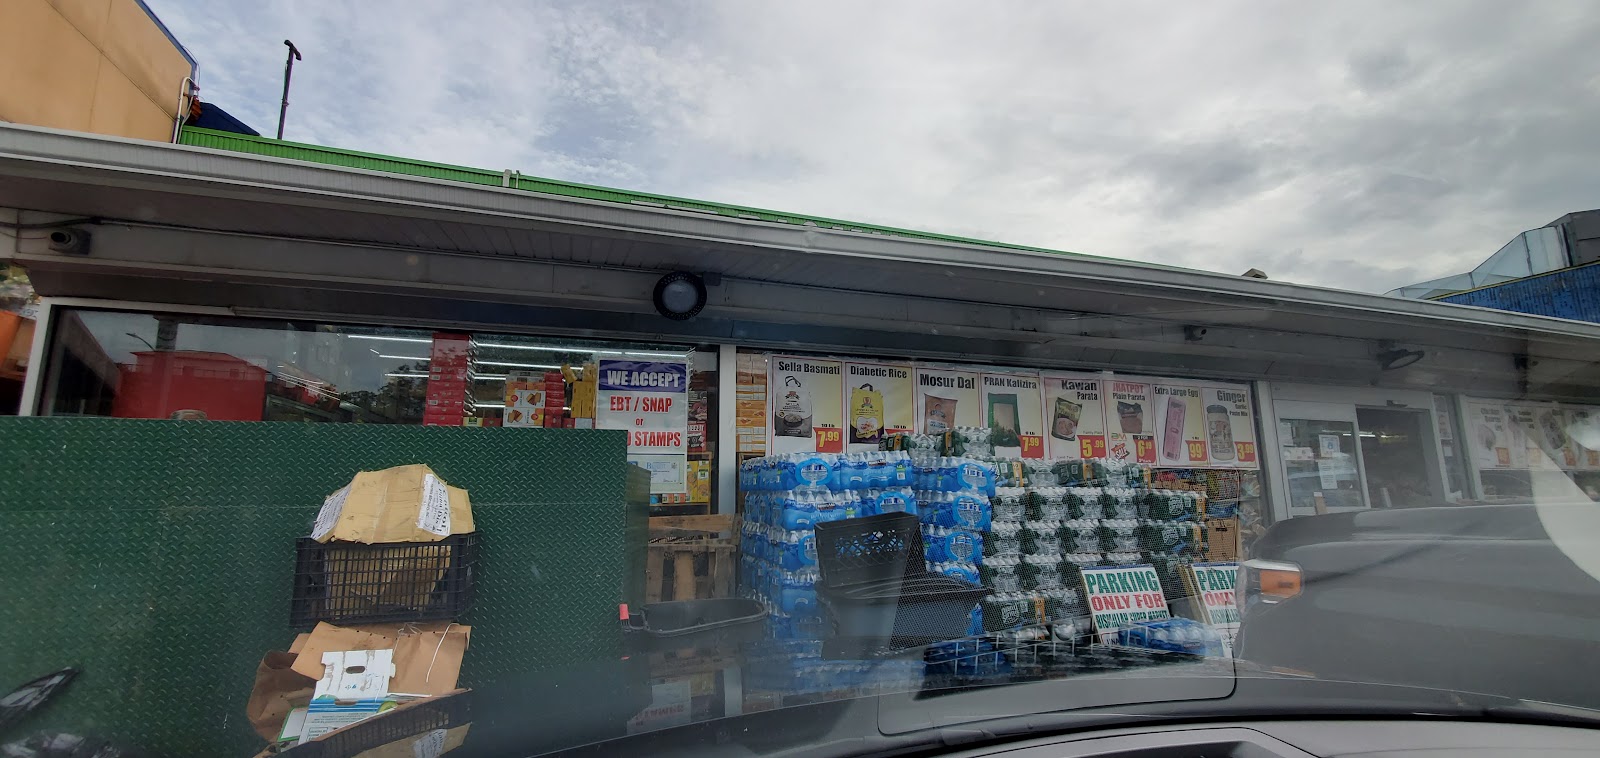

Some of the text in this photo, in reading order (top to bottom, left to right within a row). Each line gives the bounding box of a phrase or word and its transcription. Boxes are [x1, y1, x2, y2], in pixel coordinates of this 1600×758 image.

[778, 361, 840, 374] Sella Basmati
[850, 366, 907, 378] Diabetic Rice
[607, 370, 680, 388] WE ACCEPT
[920, 374, 974, 389] Mosur Dal
[984, 376, 1036, 389] PRAN Kalizira
[1061, 380, 1097, 390] Kawan
[1077, 392, 1098, 400] Parata
[1155, 387, 1199, 397] Extra Large Egg
[1217, 390, 1246, 403] Ginger
[610, 396, 673, 412] EBT / SNAP
[635, 418, 644, 426] or
[634, 431, 680, 447] STAMPS
[818, 431, 839, 447] 7.99
[1023, 437, 1039, 452] 7.99
[1084, 570, 1160, 594] PARKING
[1091, 593, 1164, 611] ONLY FOR
